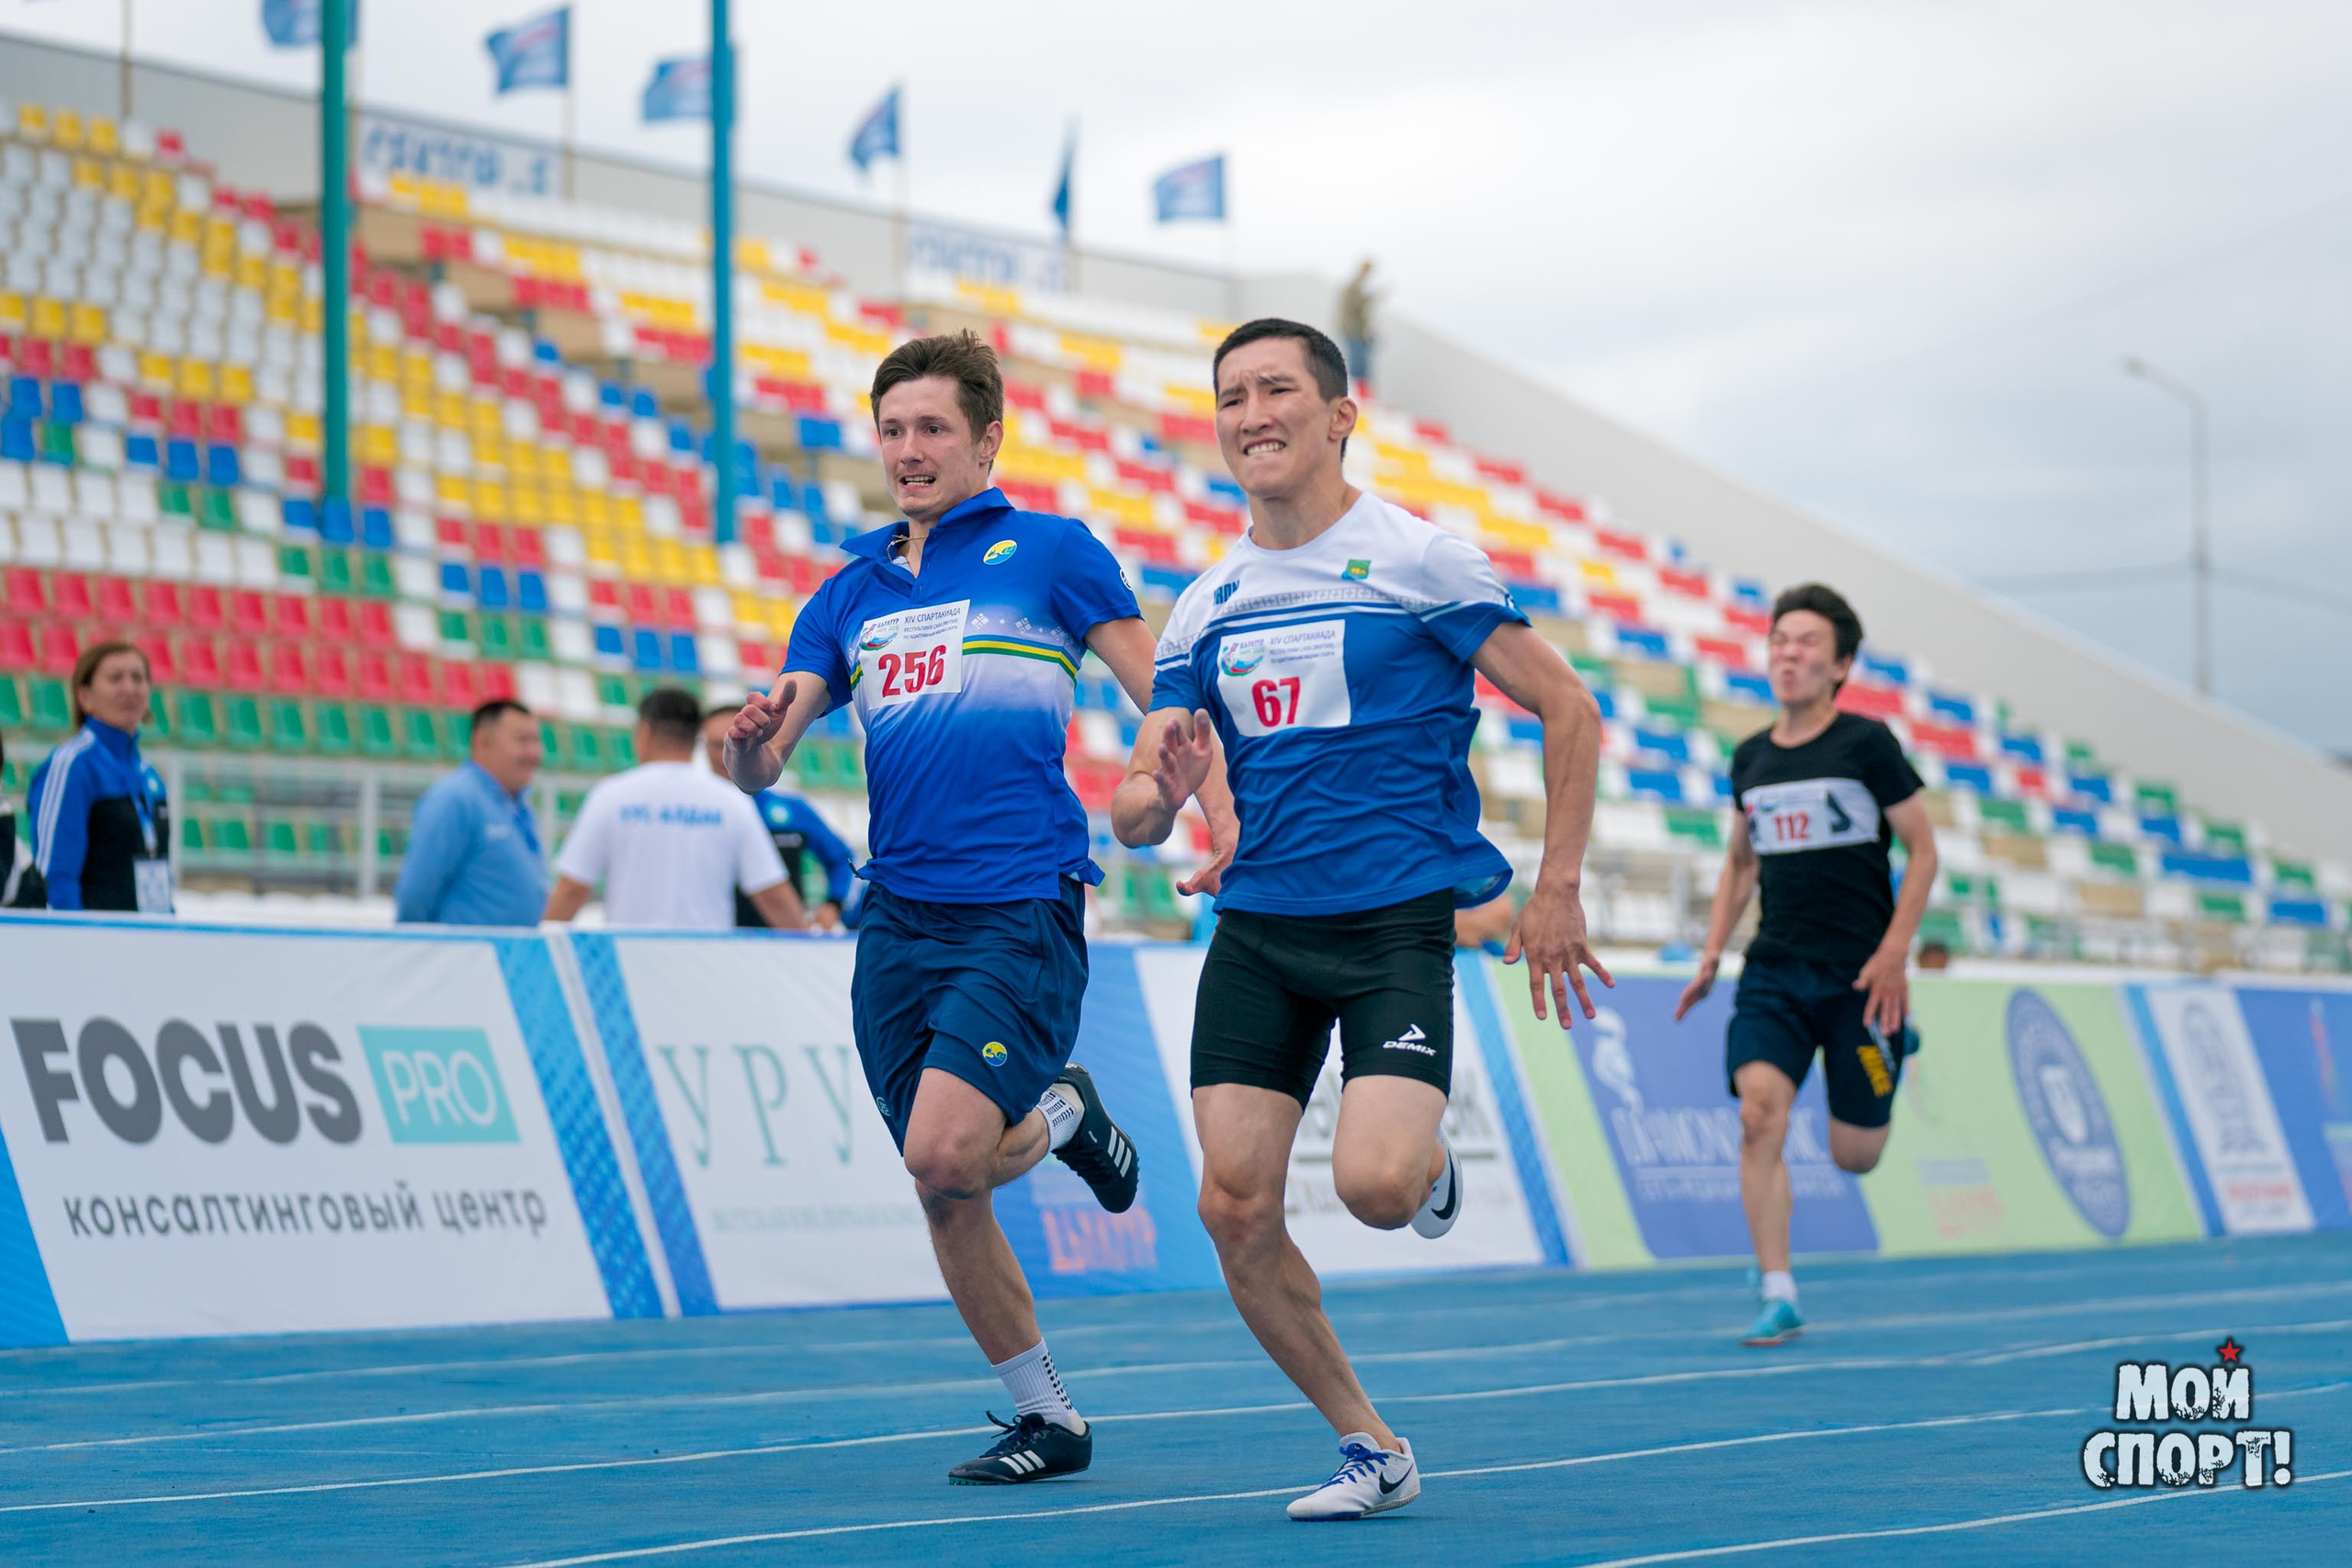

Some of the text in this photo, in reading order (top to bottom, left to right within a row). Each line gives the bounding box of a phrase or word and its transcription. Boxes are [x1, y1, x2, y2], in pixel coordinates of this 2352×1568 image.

[904, 607, 961, 624] XIV СПАРТАКИАДА
[1283, 629, 1336, 643] СПАРТАКИАДА
[878, 644, 947, 698] 256
[1251, 676, 1301, 728] 67
[1773, 811, 1811, 841] 112
[1383, 1040, 1437, 1056] DEMIX
[11, 1016, 498, 1145] FOCUS PRO
[63, 1181, 548, 1239] консалтинговый центр
